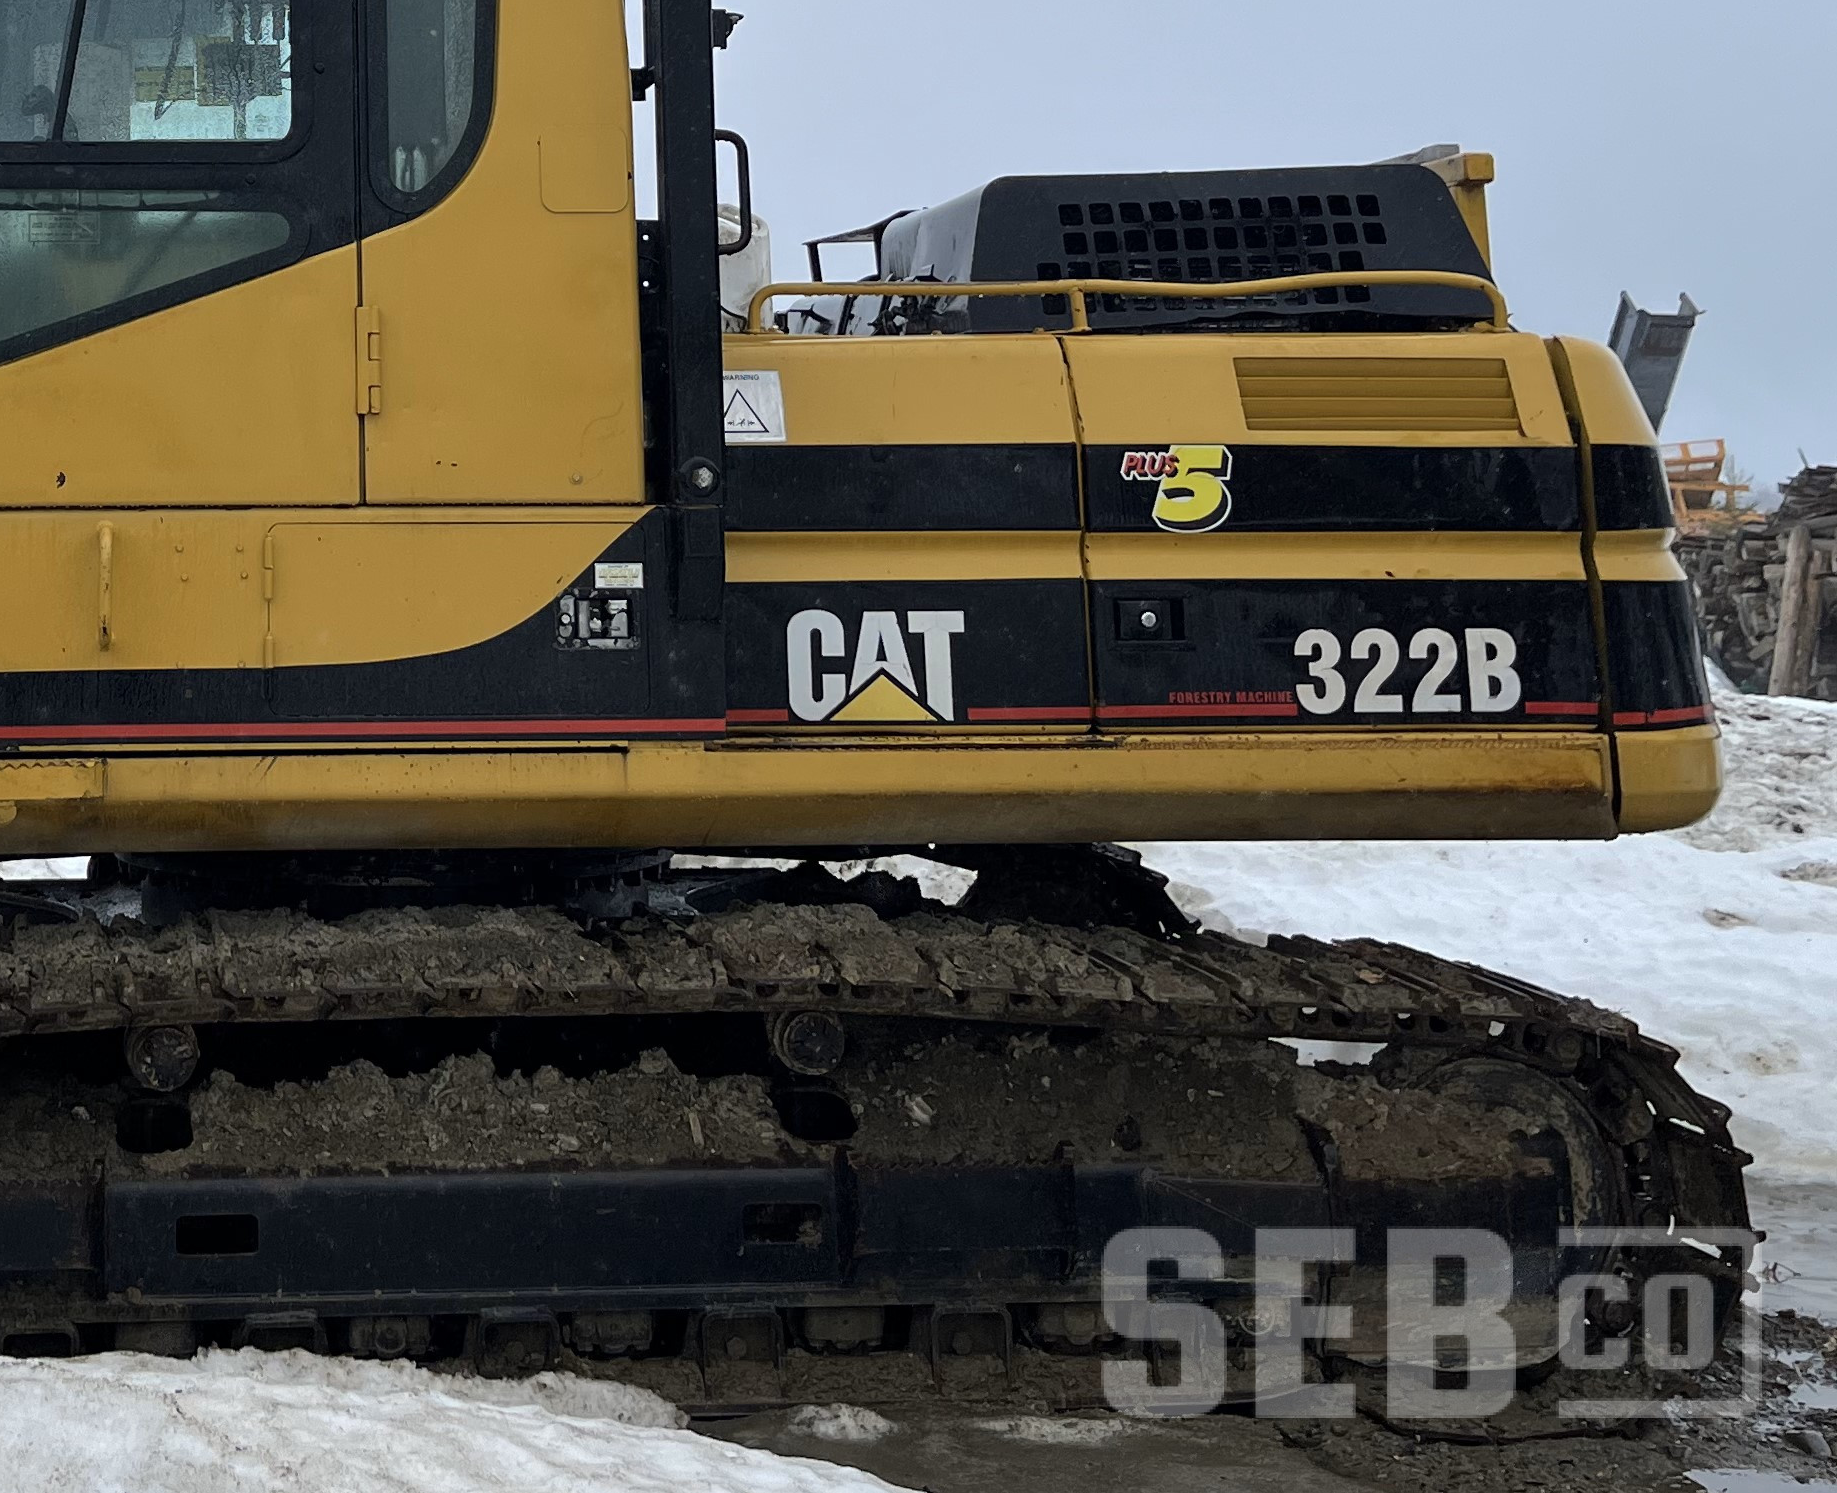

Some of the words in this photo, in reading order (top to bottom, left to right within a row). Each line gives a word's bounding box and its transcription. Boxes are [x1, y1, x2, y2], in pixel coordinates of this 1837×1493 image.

[1121, 452, 1181, 480] PLUS
[1152, 445, 1232, 533] 5
[786, 609, 965, 722] CAT
[1168, 691, 1232, 704] FORESTRY
[1235, 690, 1295, 704] MACHINE
[1293, 627, 1522, 715] 322B
